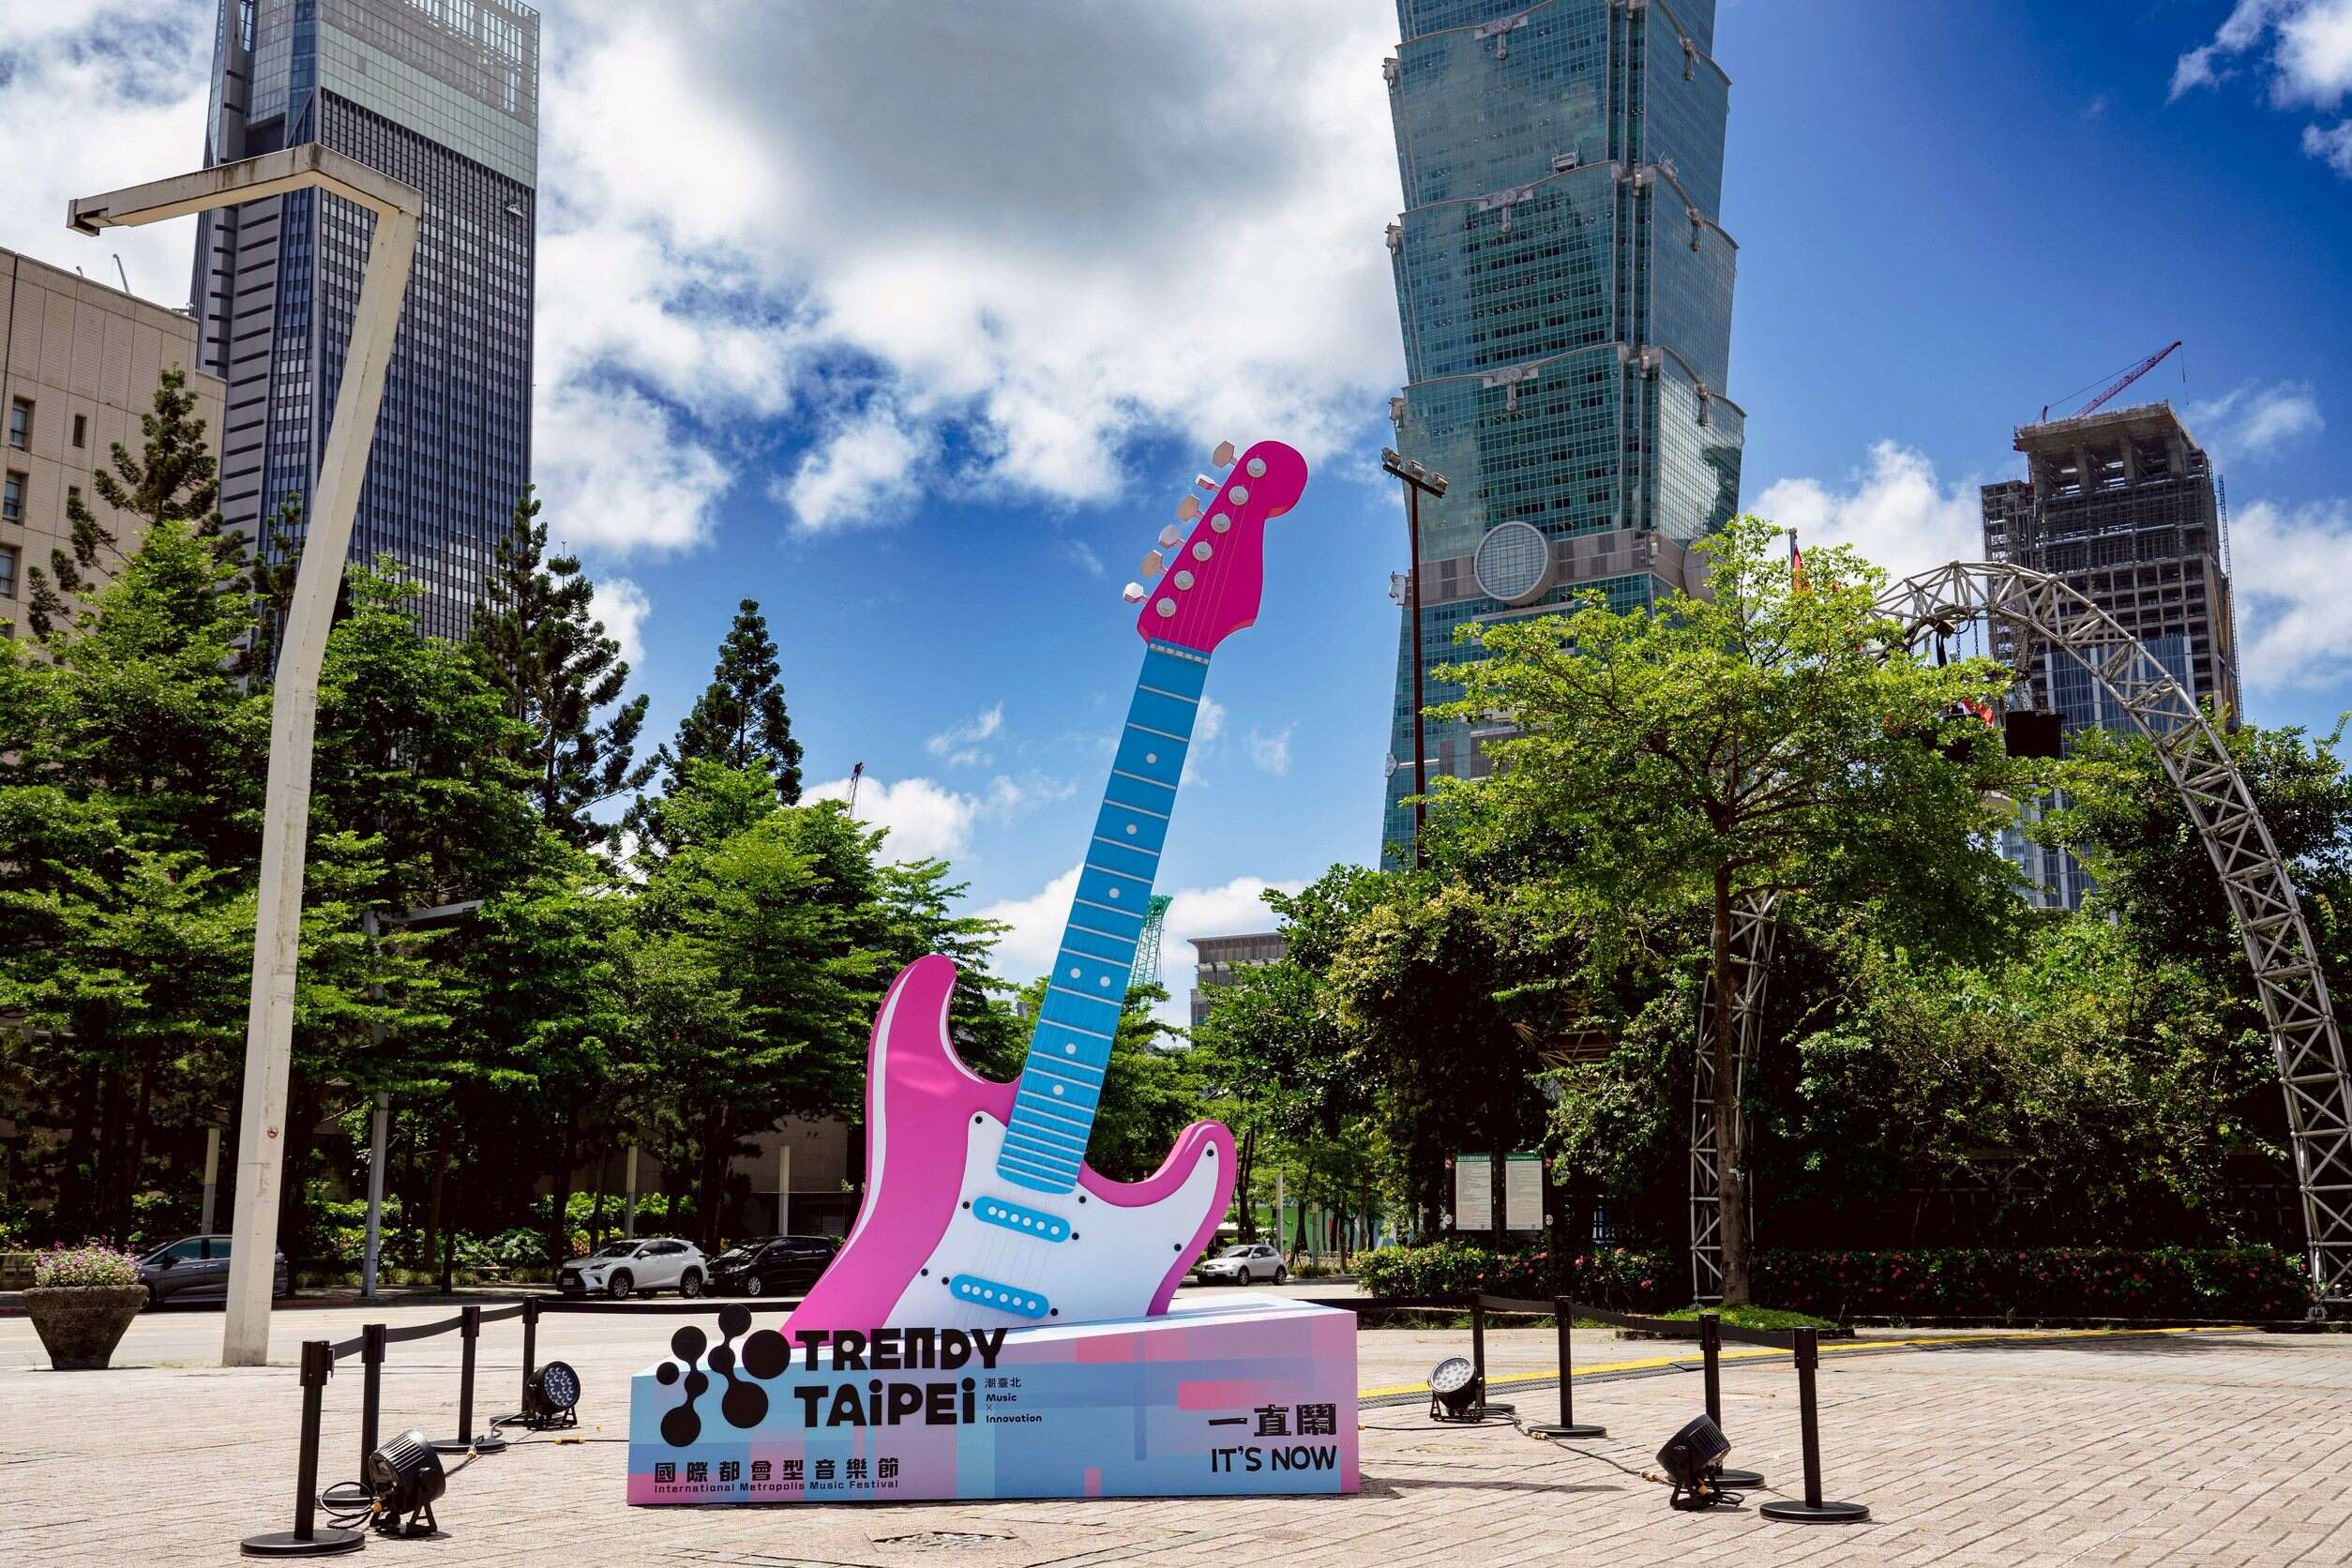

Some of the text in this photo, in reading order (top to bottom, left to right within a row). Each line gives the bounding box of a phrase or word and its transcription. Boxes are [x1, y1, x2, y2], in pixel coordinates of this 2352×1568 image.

[795, 1328, 1008, 1371] TRENDY
[985, 1377, 1021, 1388] 潮臺北
[986, 1393, 1018, 1402] Music
[986, 1413, 1043, 1424] Innovation
[1208, 1403, 1337, 1437] 一直鬧
[1212, 1445, 1337, 1472] IT'S NOW
[655, 1457, 899, 1484] 國際都會型音樂節
[655, 1480, 898, 1493] International Metropolis Music Festival
